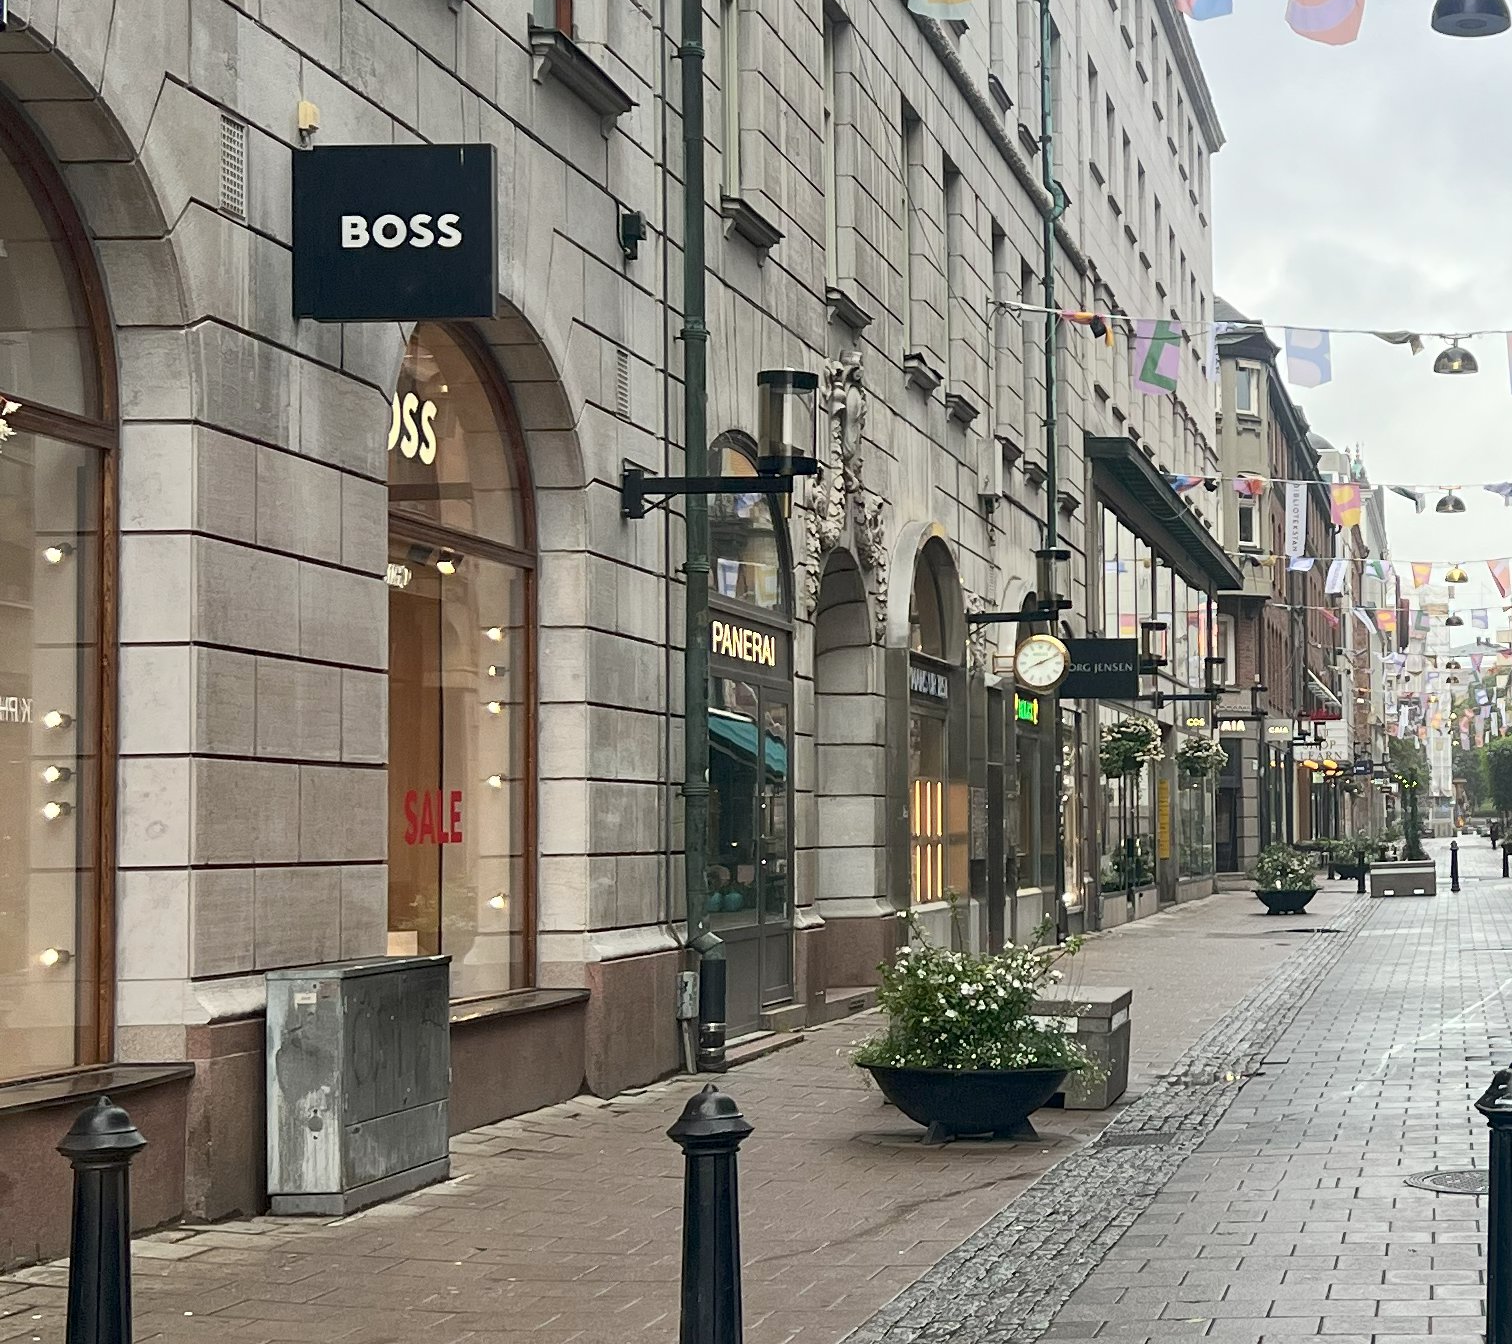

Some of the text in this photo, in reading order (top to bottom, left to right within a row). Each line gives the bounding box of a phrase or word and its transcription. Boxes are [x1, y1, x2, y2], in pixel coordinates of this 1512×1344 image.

[341, 213, 462, 248] BOSS
[387, 390, 438, 465] SS
[711, 620, 777, 667] PANERAI
[1069, 662, 1133, 674] ORG JENSEN
[1221, 720, 1246, 732] AIA
[404, 789, 463, 846] SALE
